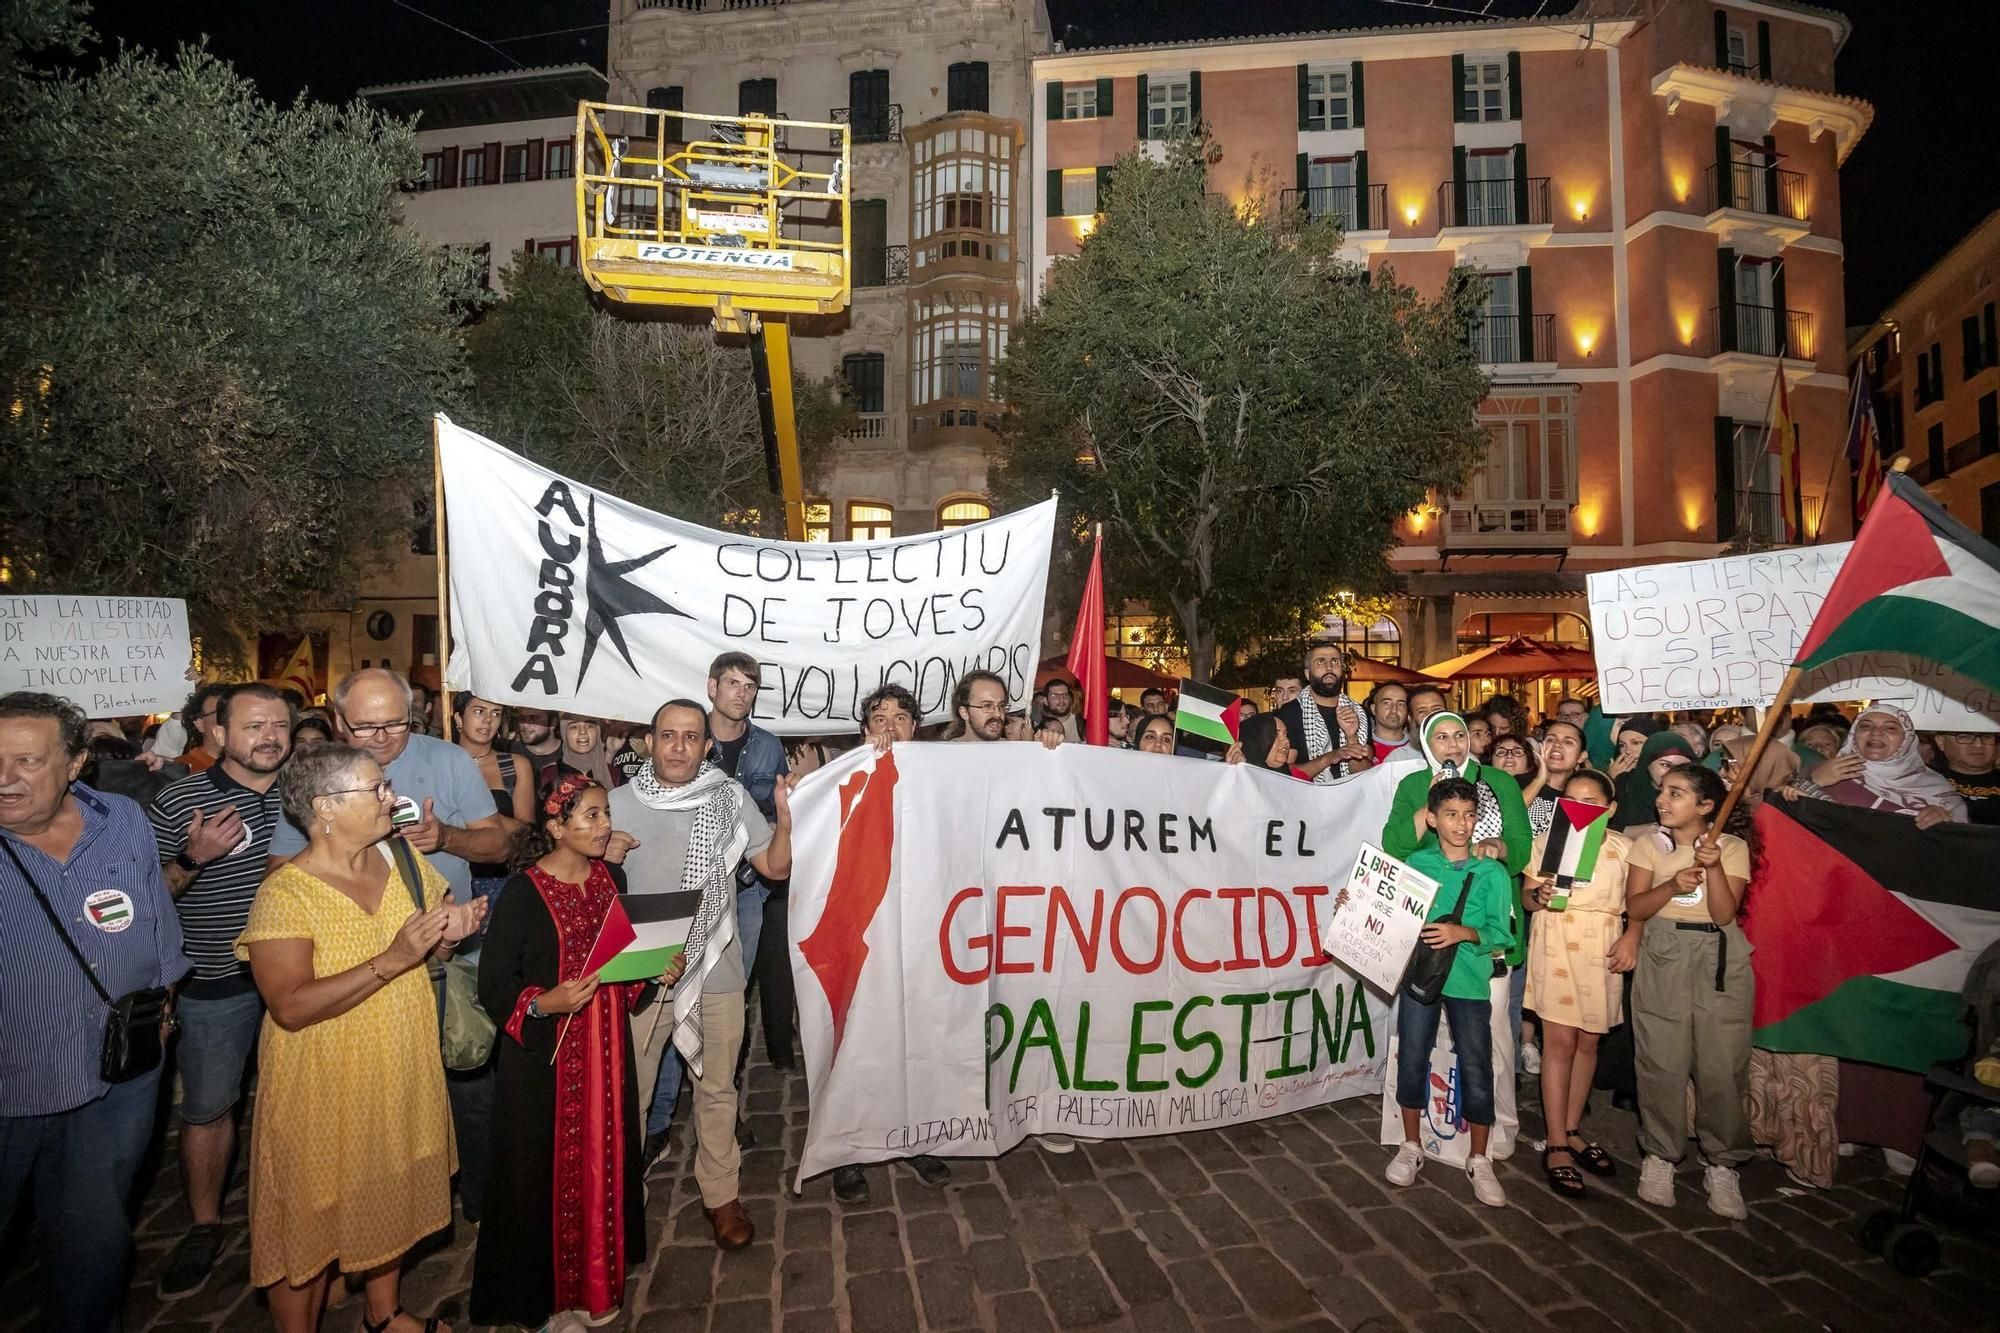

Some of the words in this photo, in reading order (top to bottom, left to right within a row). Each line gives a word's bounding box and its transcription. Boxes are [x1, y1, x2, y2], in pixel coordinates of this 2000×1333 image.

[642, 246, 790, 267] POTENCIA
[1591, 569, 1660, 605] LAS
[57, 599, 83, 618] LA
[96, 599, 172, 619] LIBERTAD
[723, 593, 789, 643] DE
[824, 588, 985, 643] JOVES
[5, 622, 25, 642] DE
[50, 621, 174, 641] PALESTINA
[36, 645, 110, 661] NUESTRA
[127, 642, 165, 660] ESTÁ
[21, 666, 157, 688] INCOMPLETA
[751, 643, 1029, 722] EVOLUCIONRIS
[94, 692, 160, 711] Palestine
[996, 806, 1218, 855] ATUREM
[1265, 820, 1316, 858] EL
[1359, 849, 1399, 882] LBRE
[938, 884, 1332, 986] GENOCIDI
[1365, 914, 1385, 936] NO
[984, 979, 1376, 1109] PALESTINA
[1007, 1095, 1039, 1133] PER
[1057, 1094, 1157, 1129] PALESTINA
[1168, 1087, 1250, 1126] MALLORCA
